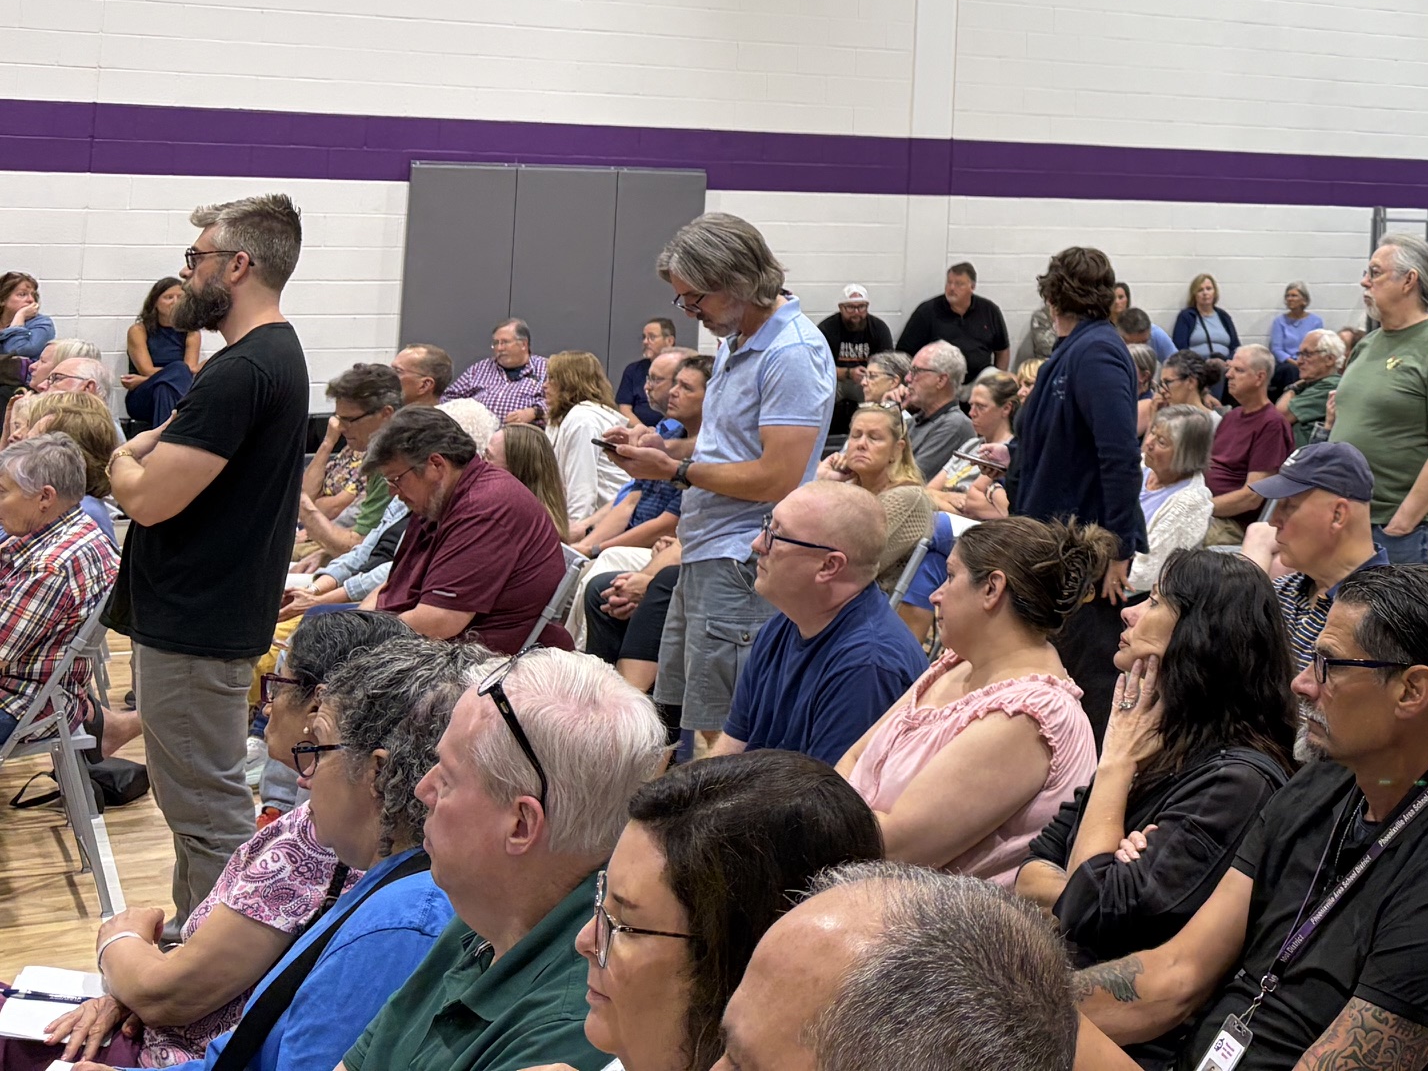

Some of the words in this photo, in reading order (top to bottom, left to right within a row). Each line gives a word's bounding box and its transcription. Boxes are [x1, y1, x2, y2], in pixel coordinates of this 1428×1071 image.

[1378, 819, 1406, 847] Phoenixville
[1402, 808, 1416, 822] Area
[1341, 870, 1357, 889] School
[1354, 854, 1372, 874] District
[1286, 933, 1304, 954] District
